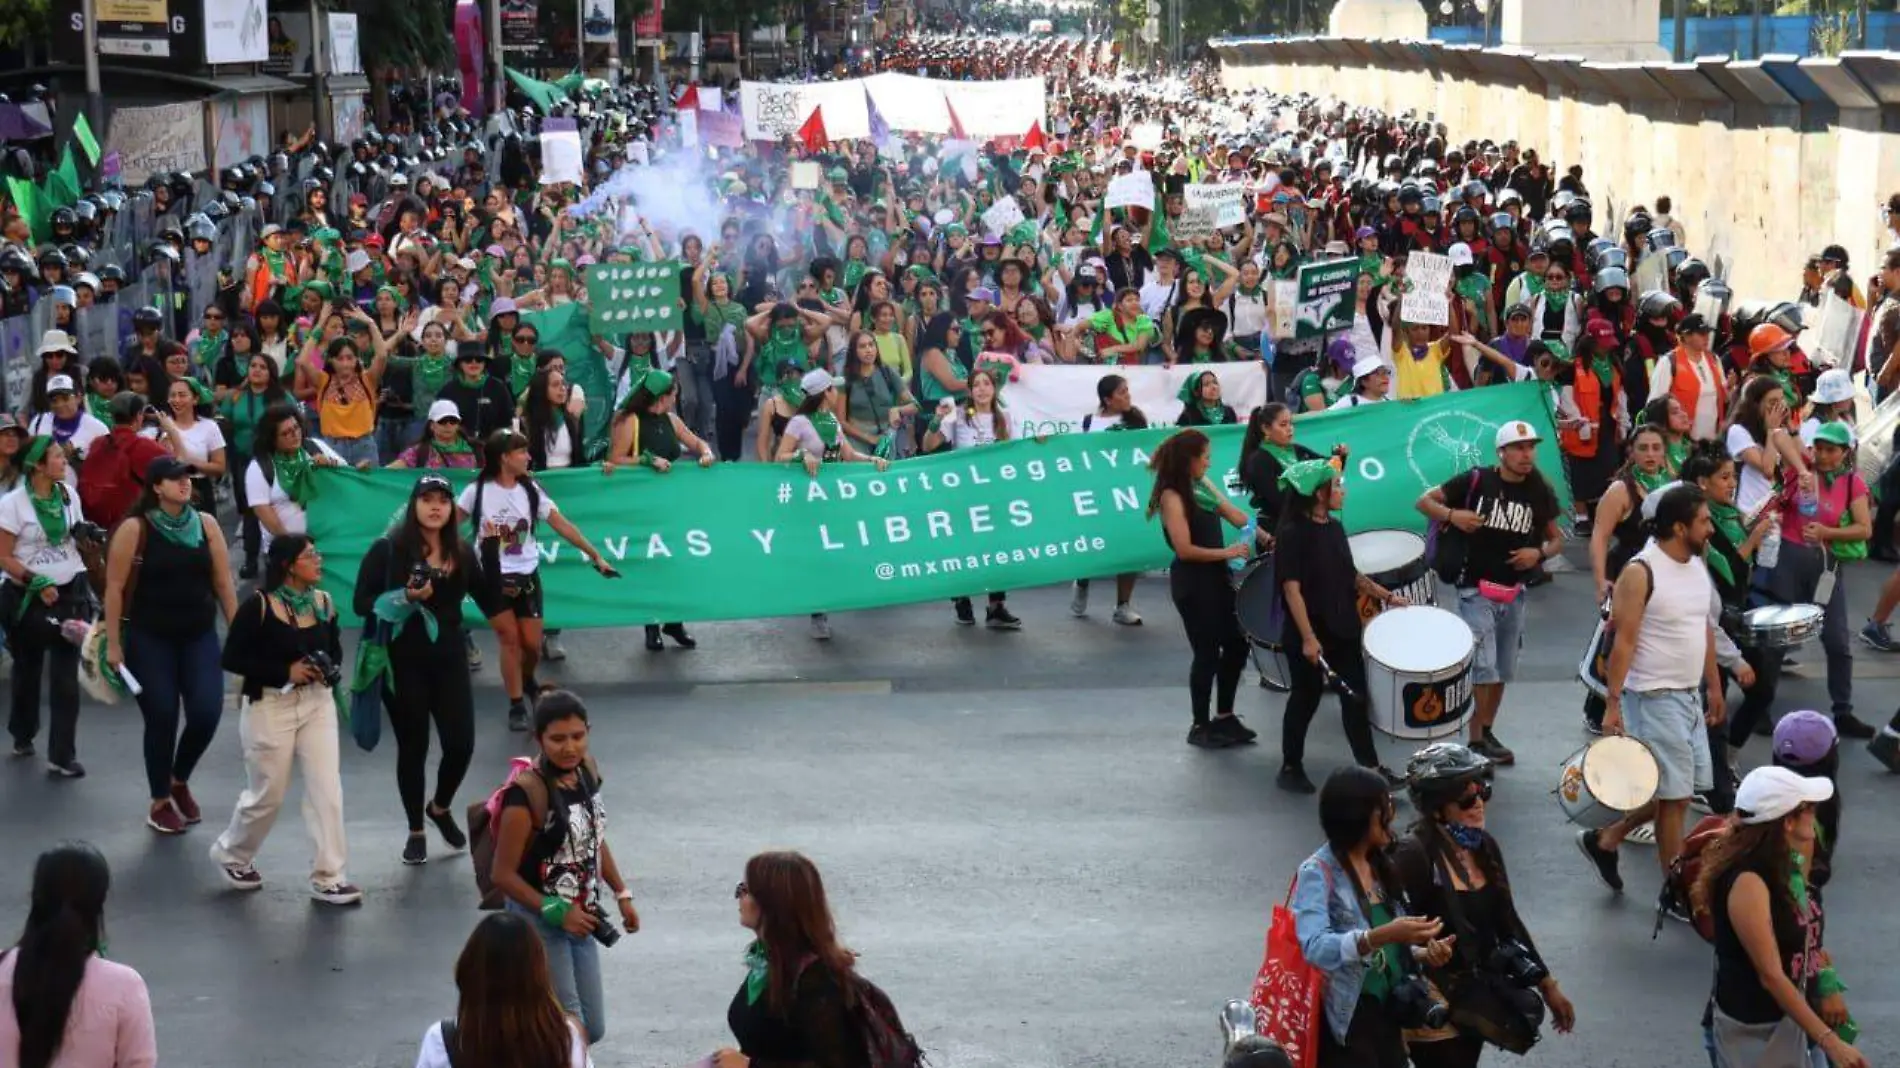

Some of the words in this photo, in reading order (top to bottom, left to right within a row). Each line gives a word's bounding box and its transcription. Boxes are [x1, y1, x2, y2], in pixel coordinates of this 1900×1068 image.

[776, 446, 1151, 504] #AbortoLegalYA
[751, 528, 776, 555] Y
[818, 498, 1034, 550] LIBRES
[1072, 485, 1141, 517] EN
[875, 533, 1107, 581] @mxmareaverde
